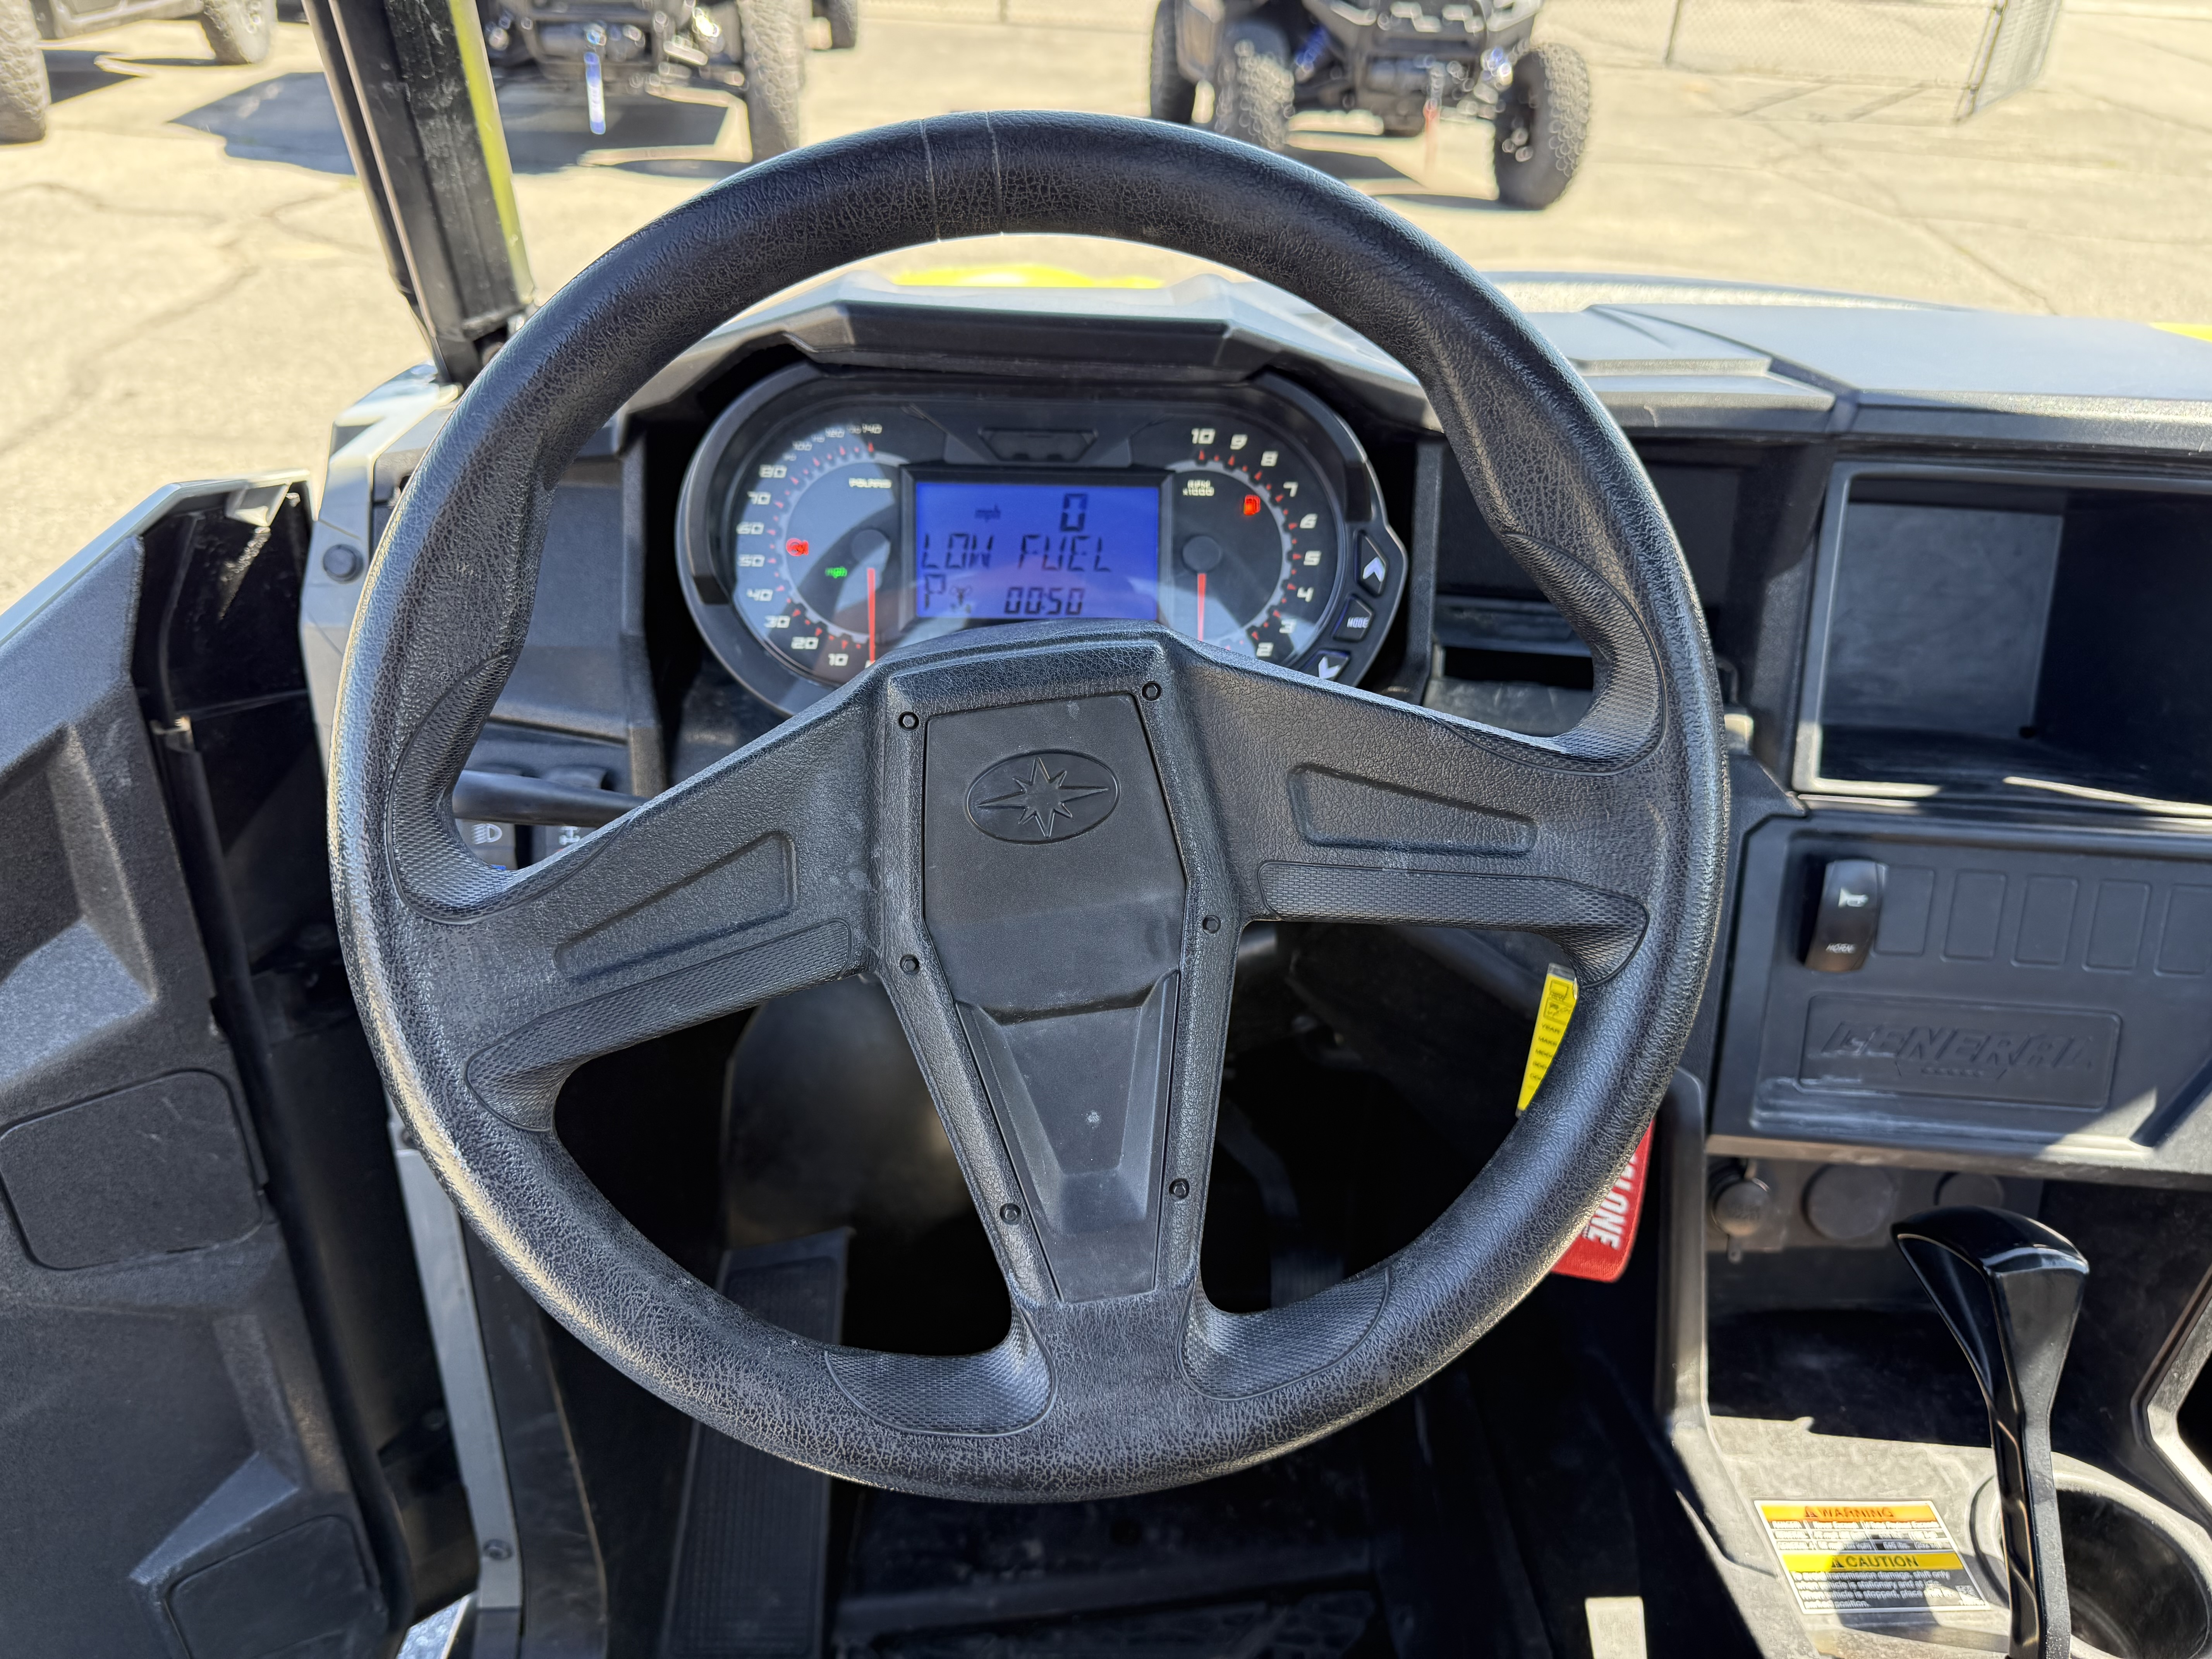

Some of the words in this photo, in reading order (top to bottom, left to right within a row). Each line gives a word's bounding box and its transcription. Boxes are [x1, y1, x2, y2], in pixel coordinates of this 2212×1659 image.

[1192, 429, 1215, 444] 10
[1230, 434, 1247, 449] 9
[1261, 451, 1278, 466] 8
[759, 465, 787, 478] 80
[1283, 482, 1298, 497] 7
[747, 492, 771, 504] 70
[1060, 493, 1088, 532] 0
[737, 522, 764, 534] 60
[1300, 514, 1317, 529] 6
[922, 533, 994, 571] LOW
[1018, 534, 1112, 572] FUEL
[1304, 551, 1321, 565] 5
[738, 555, 764, 567] 50
[747, 589, 773, 601] 40
[923, 573, 946, 610] P
[1297, 587, 1314, 602] 4
[764, 616, 790, 628] 30
[1279, 619, 1297, 634] 3
[1347, 617, 1369, 628] MODE
[792, 637, 818, 649] 20
[1256, 642, 1273, 657] 2
[829, 654, 848, 666] 10
[1826, 943, 1856, 954] HORN
[1821, 1021, 2092, 1070] GENERAL
[1817, 1506, 1894, 1518] WARNING
[1846, 1555, 1919, 1568] CAUTION
[1932, 1570, 1950, 1580] only
